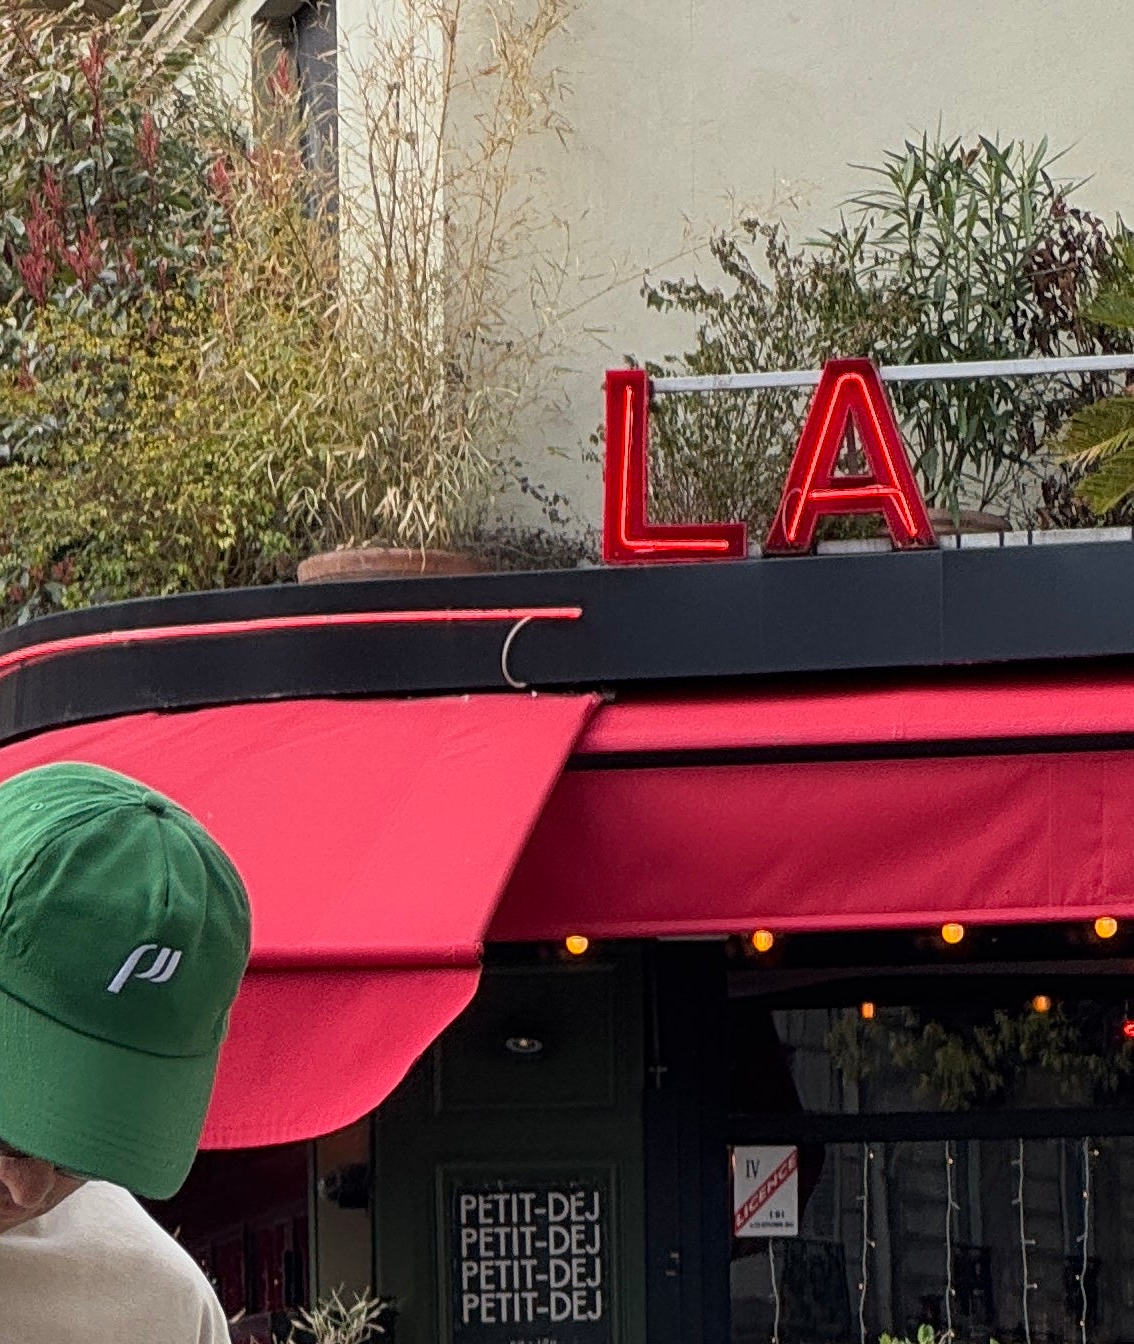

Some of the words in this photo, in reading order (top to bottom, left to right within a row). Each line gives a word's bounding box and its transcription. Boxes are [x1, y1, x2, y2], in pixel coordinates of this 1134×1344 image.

[602, 357, 937, 563] LA
[746, 1159, 760, 1178] IV
[735, 1152, 797, 1228] LICENCE
[461, 1224, 601, 1257] PETIT-DEJ
[462, 1257, 602, 1290] PETIT-DEJ
[462, 1290, 603, 1323] PETIT-DEJ
